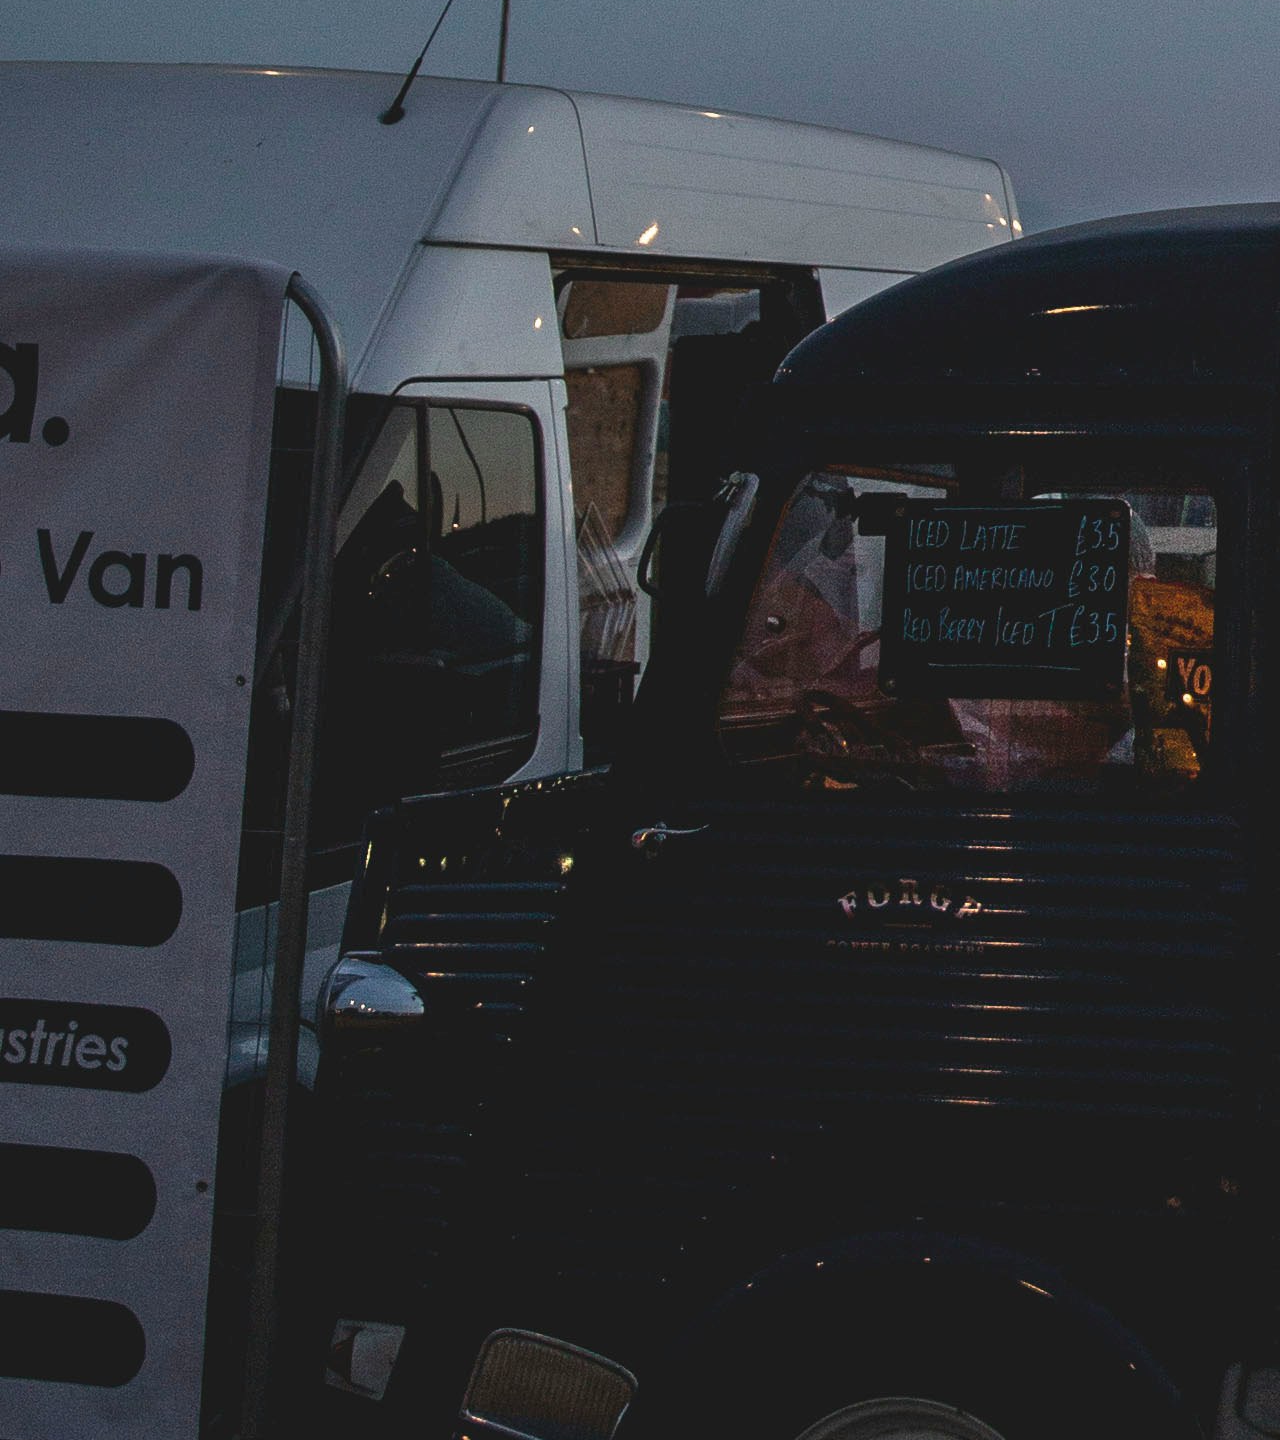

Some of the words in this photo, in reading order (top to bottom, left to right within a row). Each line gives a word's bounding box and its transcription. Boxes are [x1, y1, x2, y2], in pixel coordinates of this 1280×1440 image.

[908, 518, 950, 551] ICED
[959, 519, 1027, 552] LATTE
[37, 528, 204, 611] Van
[905, 563, 947, 594] ICED
[952, 564, 1056, 592] AMERICANO
[901, 608, 931, 644] RED
[938, 605, 987, 645] BERRY
[993, 605, 1036, 647] ICED
[1038, 602, 1075, 649] T
[0, 1019, 130, 1072] stries
